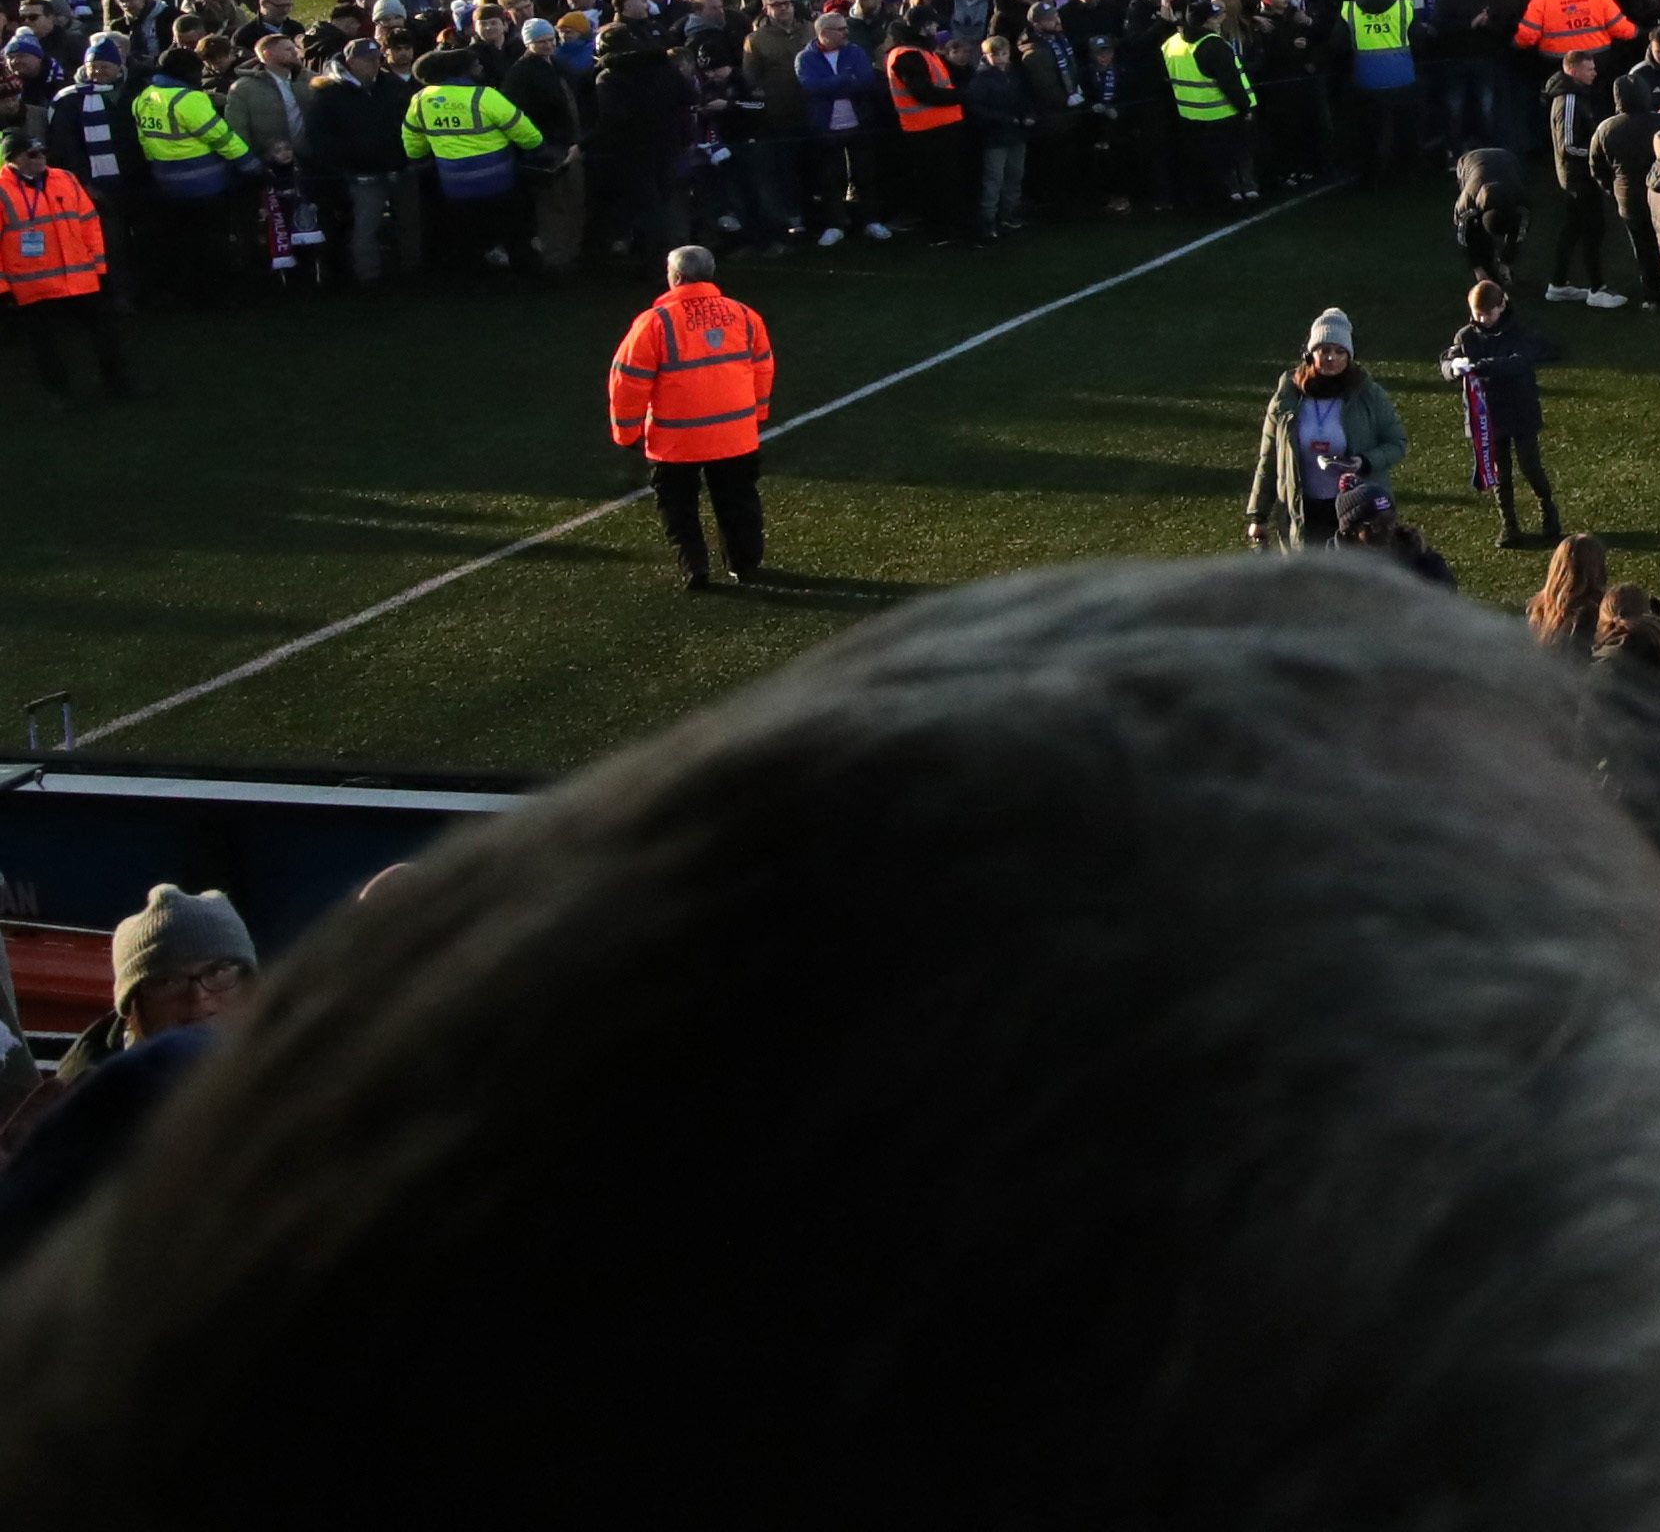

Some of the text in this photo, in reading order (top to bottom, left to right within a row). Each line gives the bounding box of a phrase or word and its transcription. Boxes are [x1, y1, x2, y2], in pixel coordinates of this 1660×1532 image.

[1364, 23, 1390, 34] 793
[1566, 18, 1590, 29] 102
[142, 117, 162, 130] 236
[434, 117, 460, 128] 419
[680, 296, 726, 309] DEPUTY
[686, 304, 730, 318] SAFETY
[686, 314, 736, 332] OFFICER
[1479, 414, 1490, 447] PALACE
